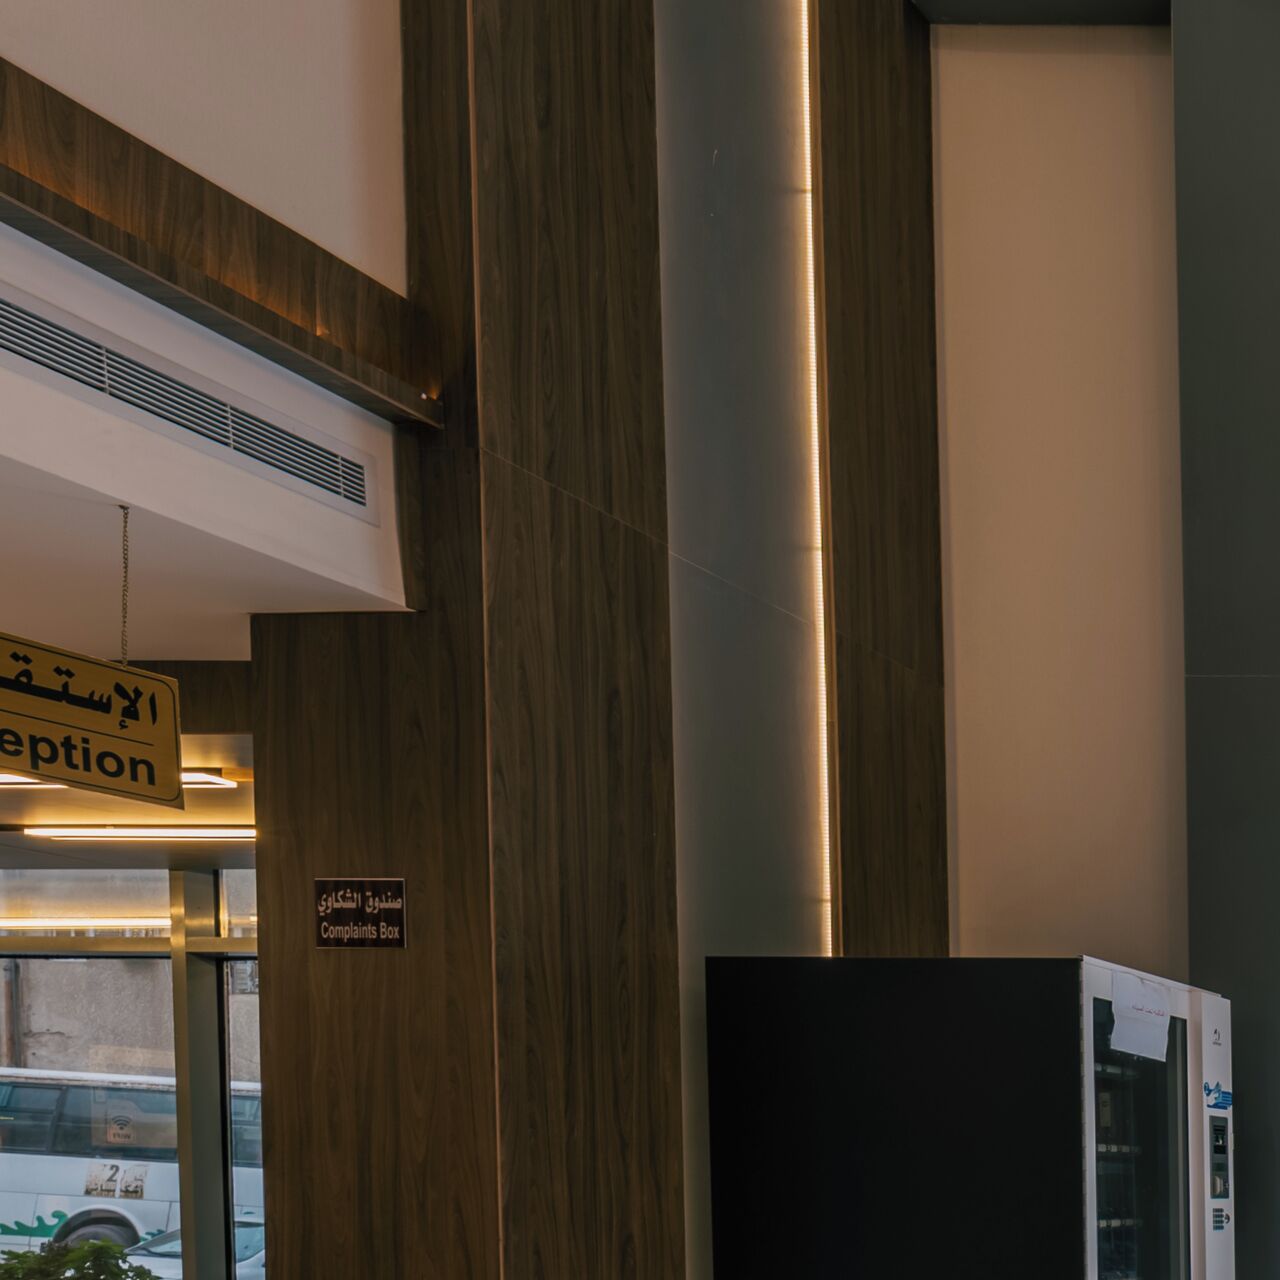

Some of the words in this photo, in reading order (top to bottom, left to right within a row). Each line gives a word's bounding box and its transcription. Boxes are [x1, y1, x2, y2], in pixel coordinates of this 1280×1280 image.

[365, 891, 403, 914] صندوق
[321, 921, 378, 943] Complaints
[380, 921, 400, 940] Box
[107, 1164, 120, 1182] 2
